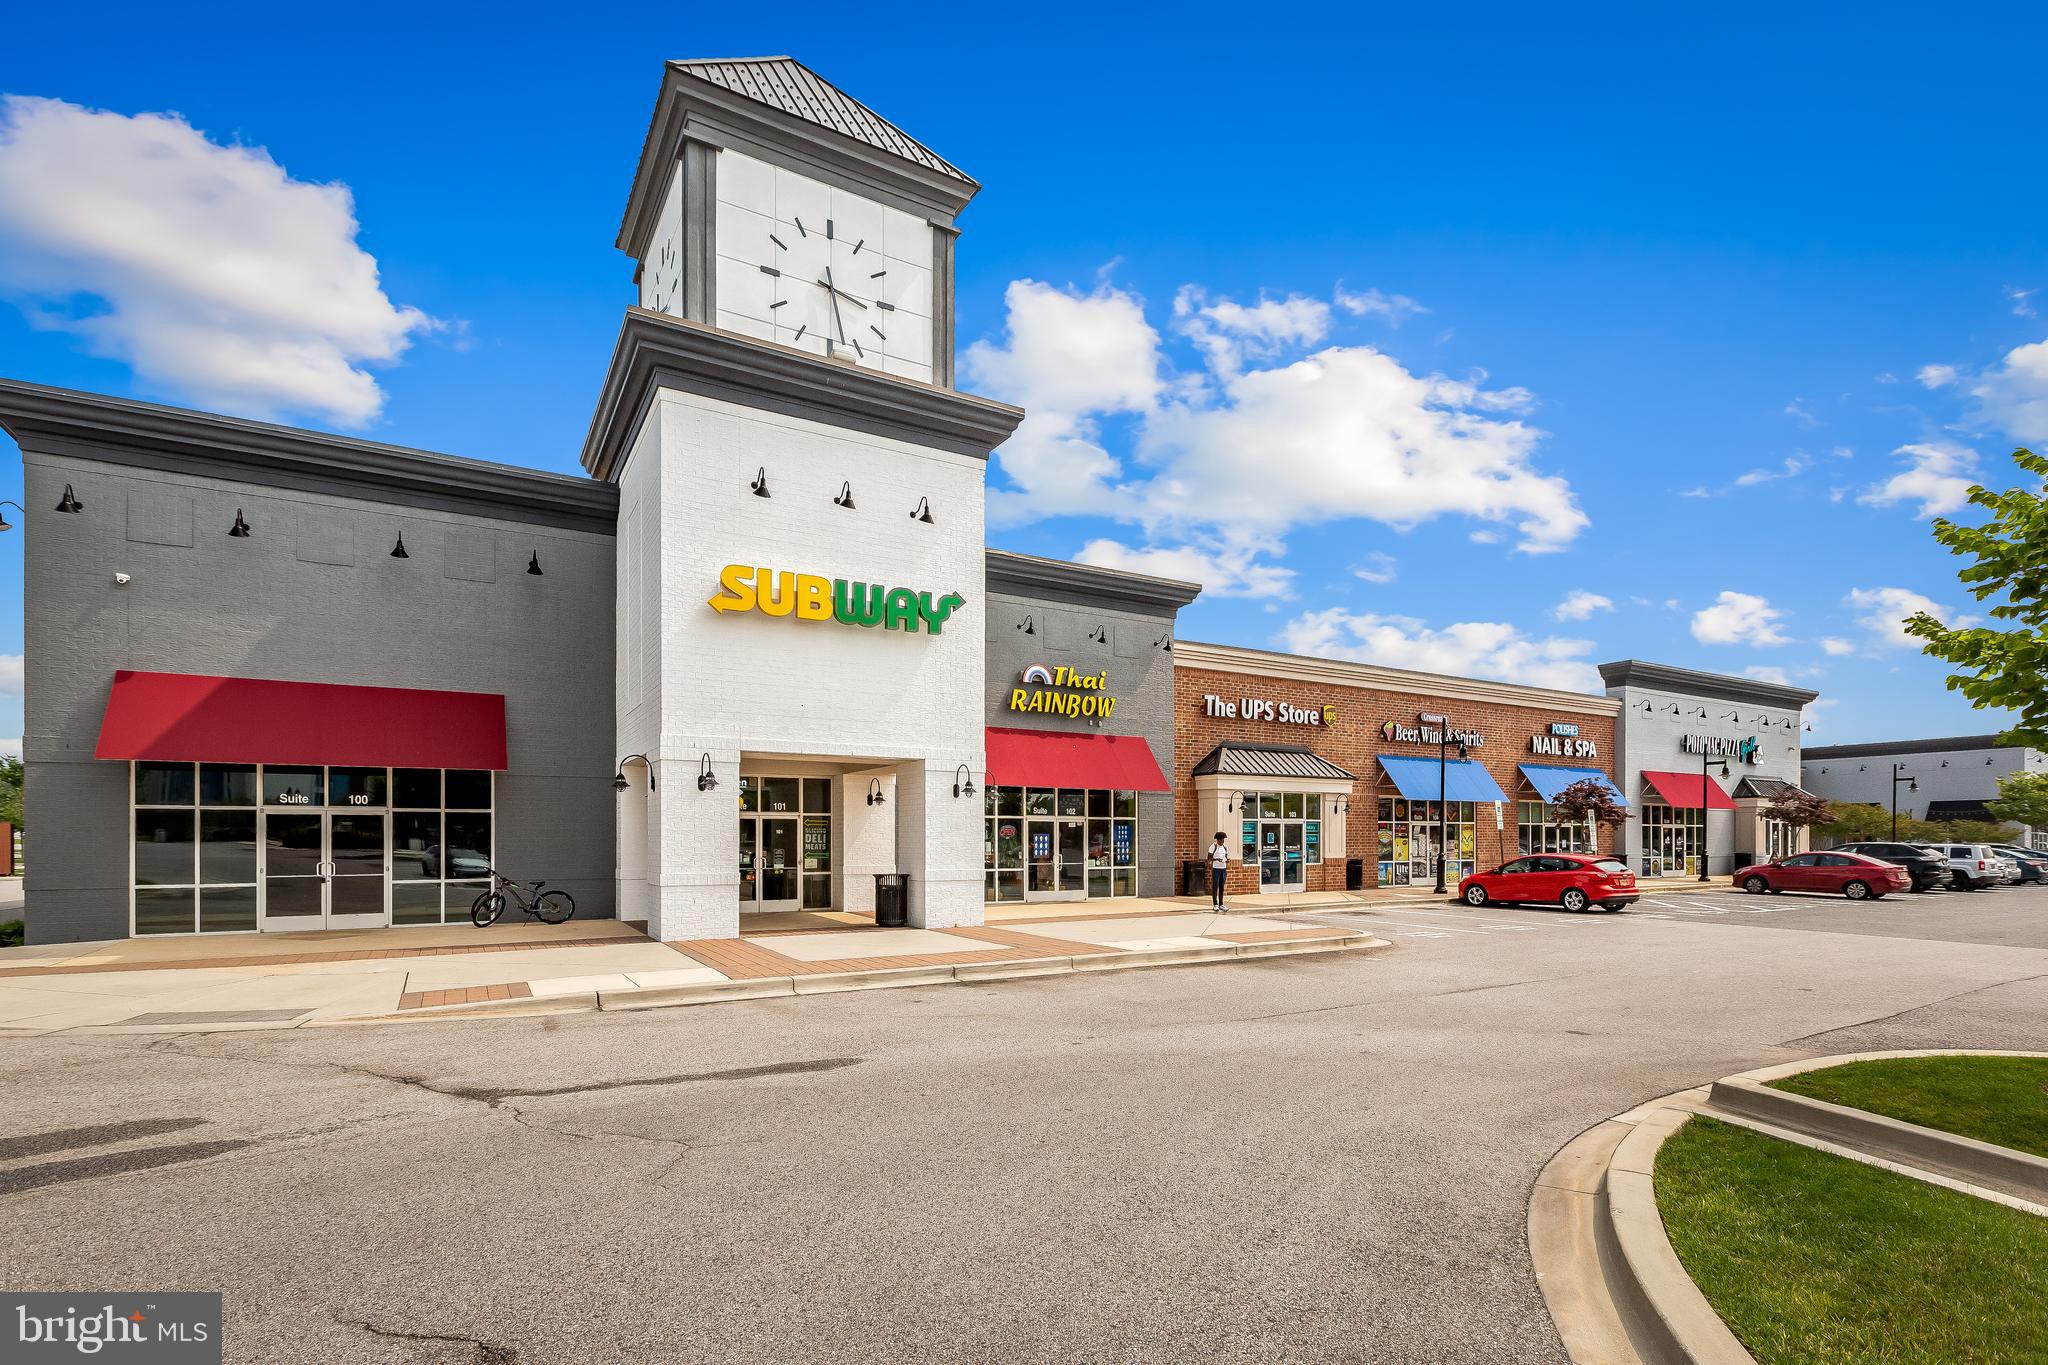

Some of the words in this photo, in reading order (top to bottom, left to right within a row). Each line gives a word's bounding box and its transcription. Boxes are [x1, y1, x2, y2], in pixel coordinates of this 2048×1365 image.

[708, 564, 966, 634] SUBWAY
[1053, 665, 1107, 690] Thai
[1010, 688, 1117, 719] RAINBOW
[1204, 694, 1236, 718] The
[1241, 698, 1274, 722] UPS
[1279, 702, 1320, 726] Store
[1395, 723, 1420, 746] Beer,
[1445, 729, 1454, 742] &
[1552, 723, 1579, 736] POLISHES
[1532, 735, 1562, 756] NAIL
[1563, 738, 1574, 756] &
[1575, 740, 1598, 758] SPA
[279, 793, 309, 804] Suite
[348, 795, 369, 805] 100
[773, 803, 786, 811] 101
[1033, 807, 1048, 815] Suite
[805, 834, 827, 843] DELI
